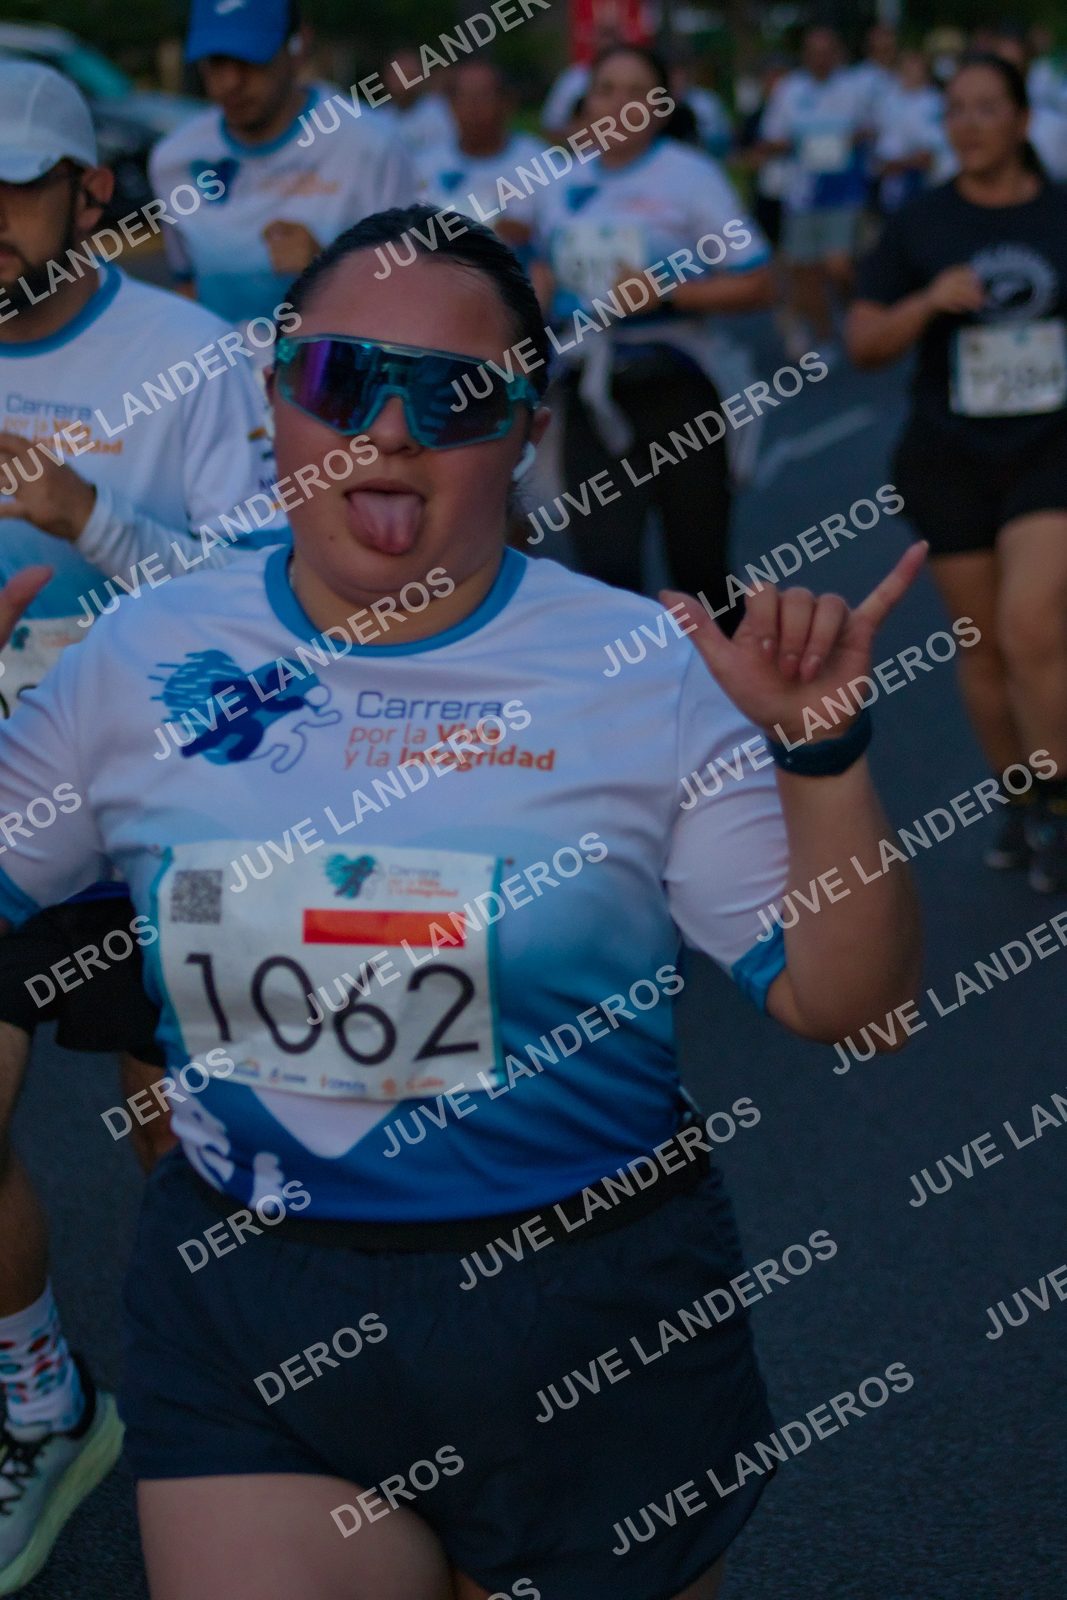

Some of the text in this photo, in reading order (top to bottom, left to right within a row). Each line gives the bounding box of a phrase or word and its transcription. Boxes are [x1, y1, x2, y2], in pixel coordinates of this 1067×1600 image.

[356, 690, 502, 720] Carrera
[348, 726, 398, 746] por
[402, 720, 428, 745] la
[344, 744, 557, 772] y la Integridad
[184, 952, 480, 1066] 1062
